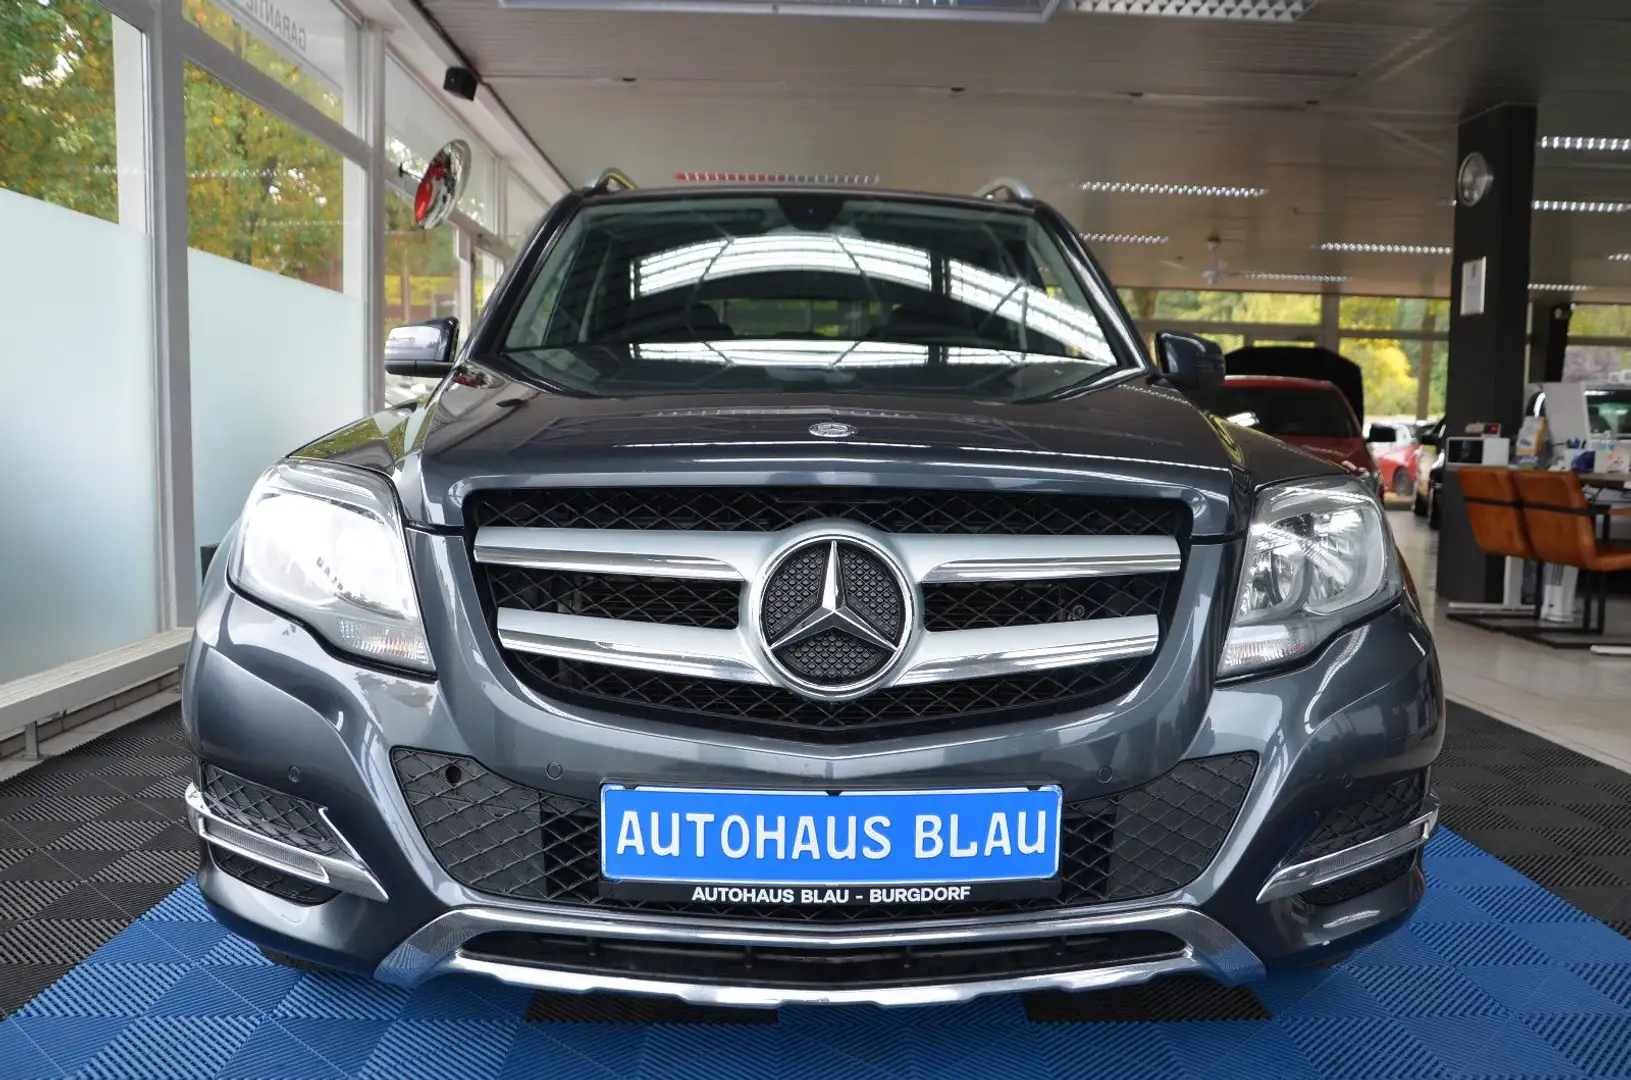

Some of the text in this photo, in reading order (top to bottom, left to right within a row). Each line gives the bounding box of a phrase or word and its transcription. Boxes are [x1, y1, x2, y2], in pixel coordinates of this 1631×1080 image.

[616, 810, 1046, 860] AUTOHAUS BLAU
[692, 886, 795, 902] AUTOHAUS
[801, 889, 849, 904] BLAU
[869, 886, 971, 903] BURGDORF
